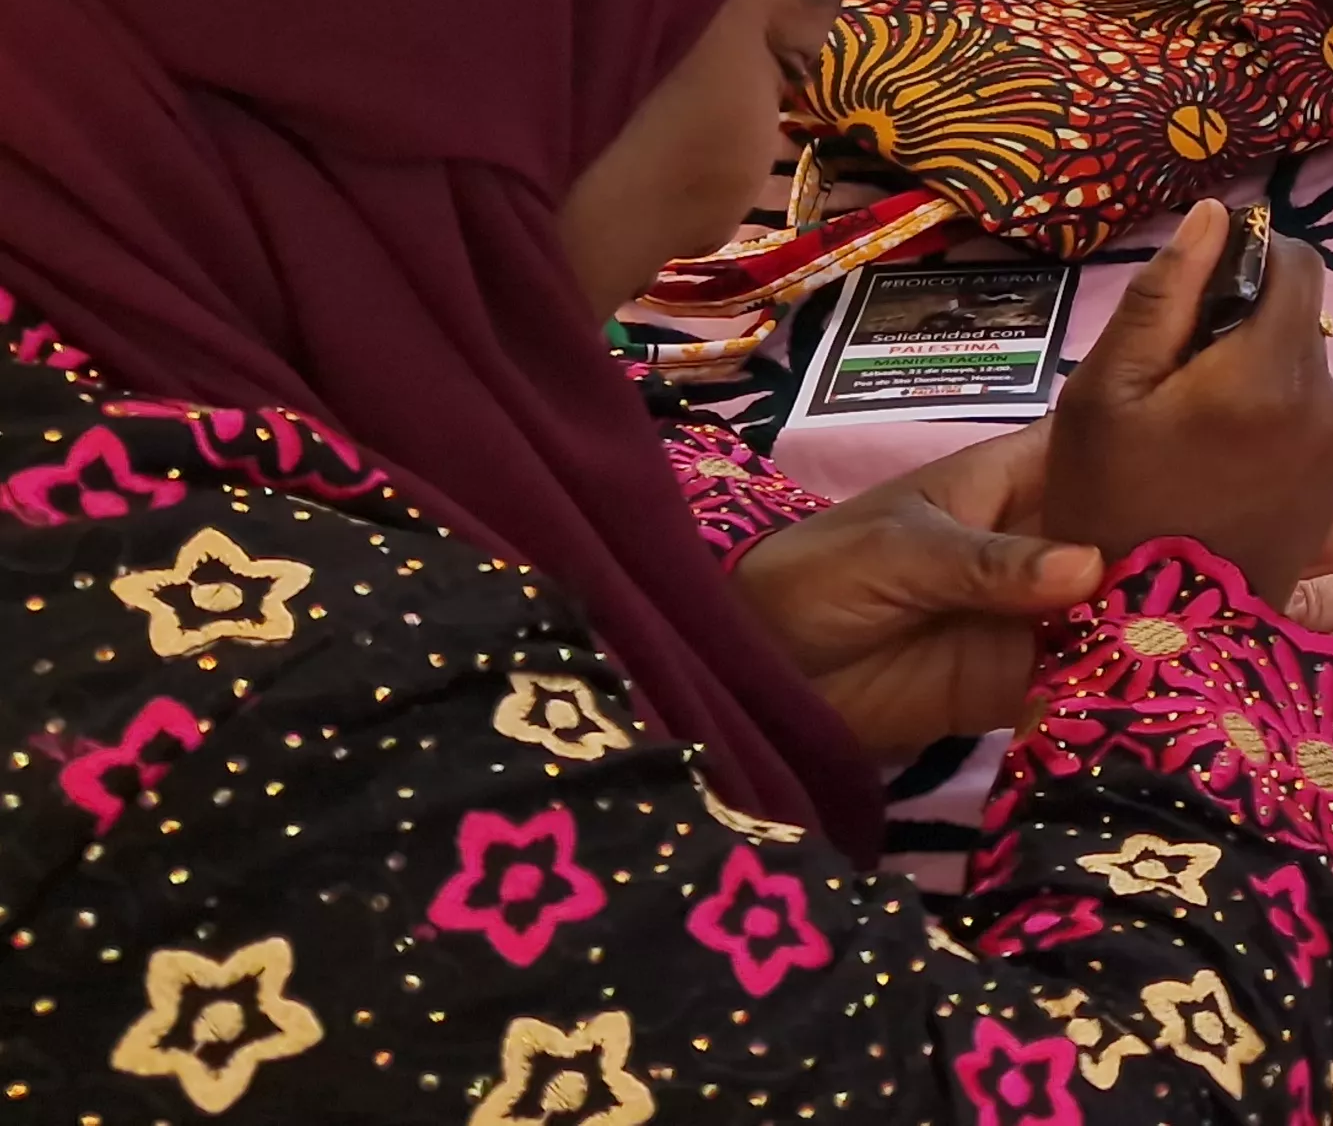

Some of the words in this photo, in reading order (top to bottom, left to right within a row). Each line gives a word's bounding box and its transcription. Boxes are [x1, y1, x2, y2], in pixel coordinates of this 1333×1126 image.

[973, 276, 986, 286] A
[872, 329, 985, 342] Solidaridad
[989, 328, 1026, 339] con
[888, 342, 1000, 354] PALESTINA
[924, 367, 939, 375] de
